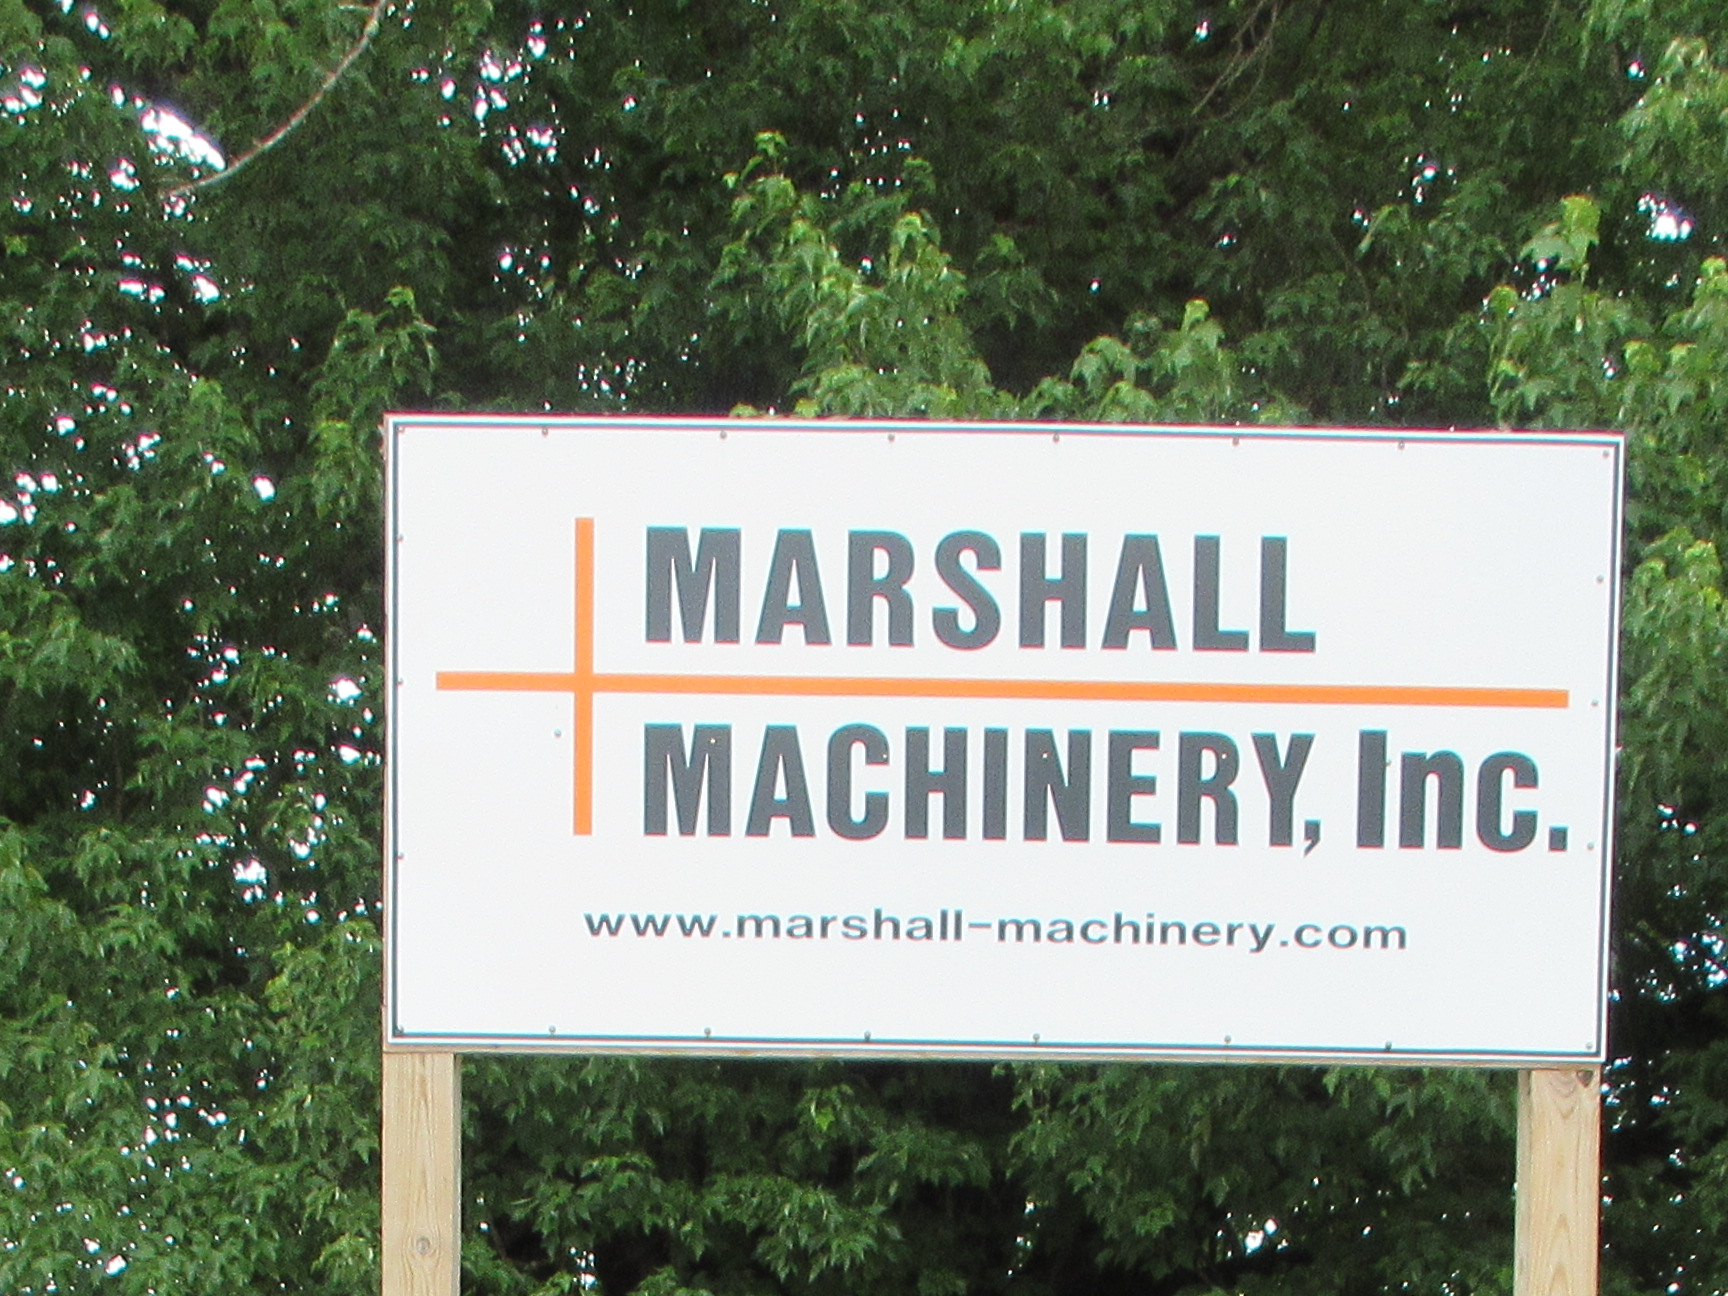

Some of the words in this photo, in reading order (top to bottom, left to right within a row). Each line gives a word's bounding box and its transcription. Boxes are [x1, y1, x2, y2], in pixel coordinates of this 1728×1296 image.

[646, 525, 1316, 654] MARSHALL
[644, 723, 1322, 857] MACHINERY,
[1356, 729, 1568, 853] Inc.
[583, 907, 1408, 953] www.marshall-machinery.com
